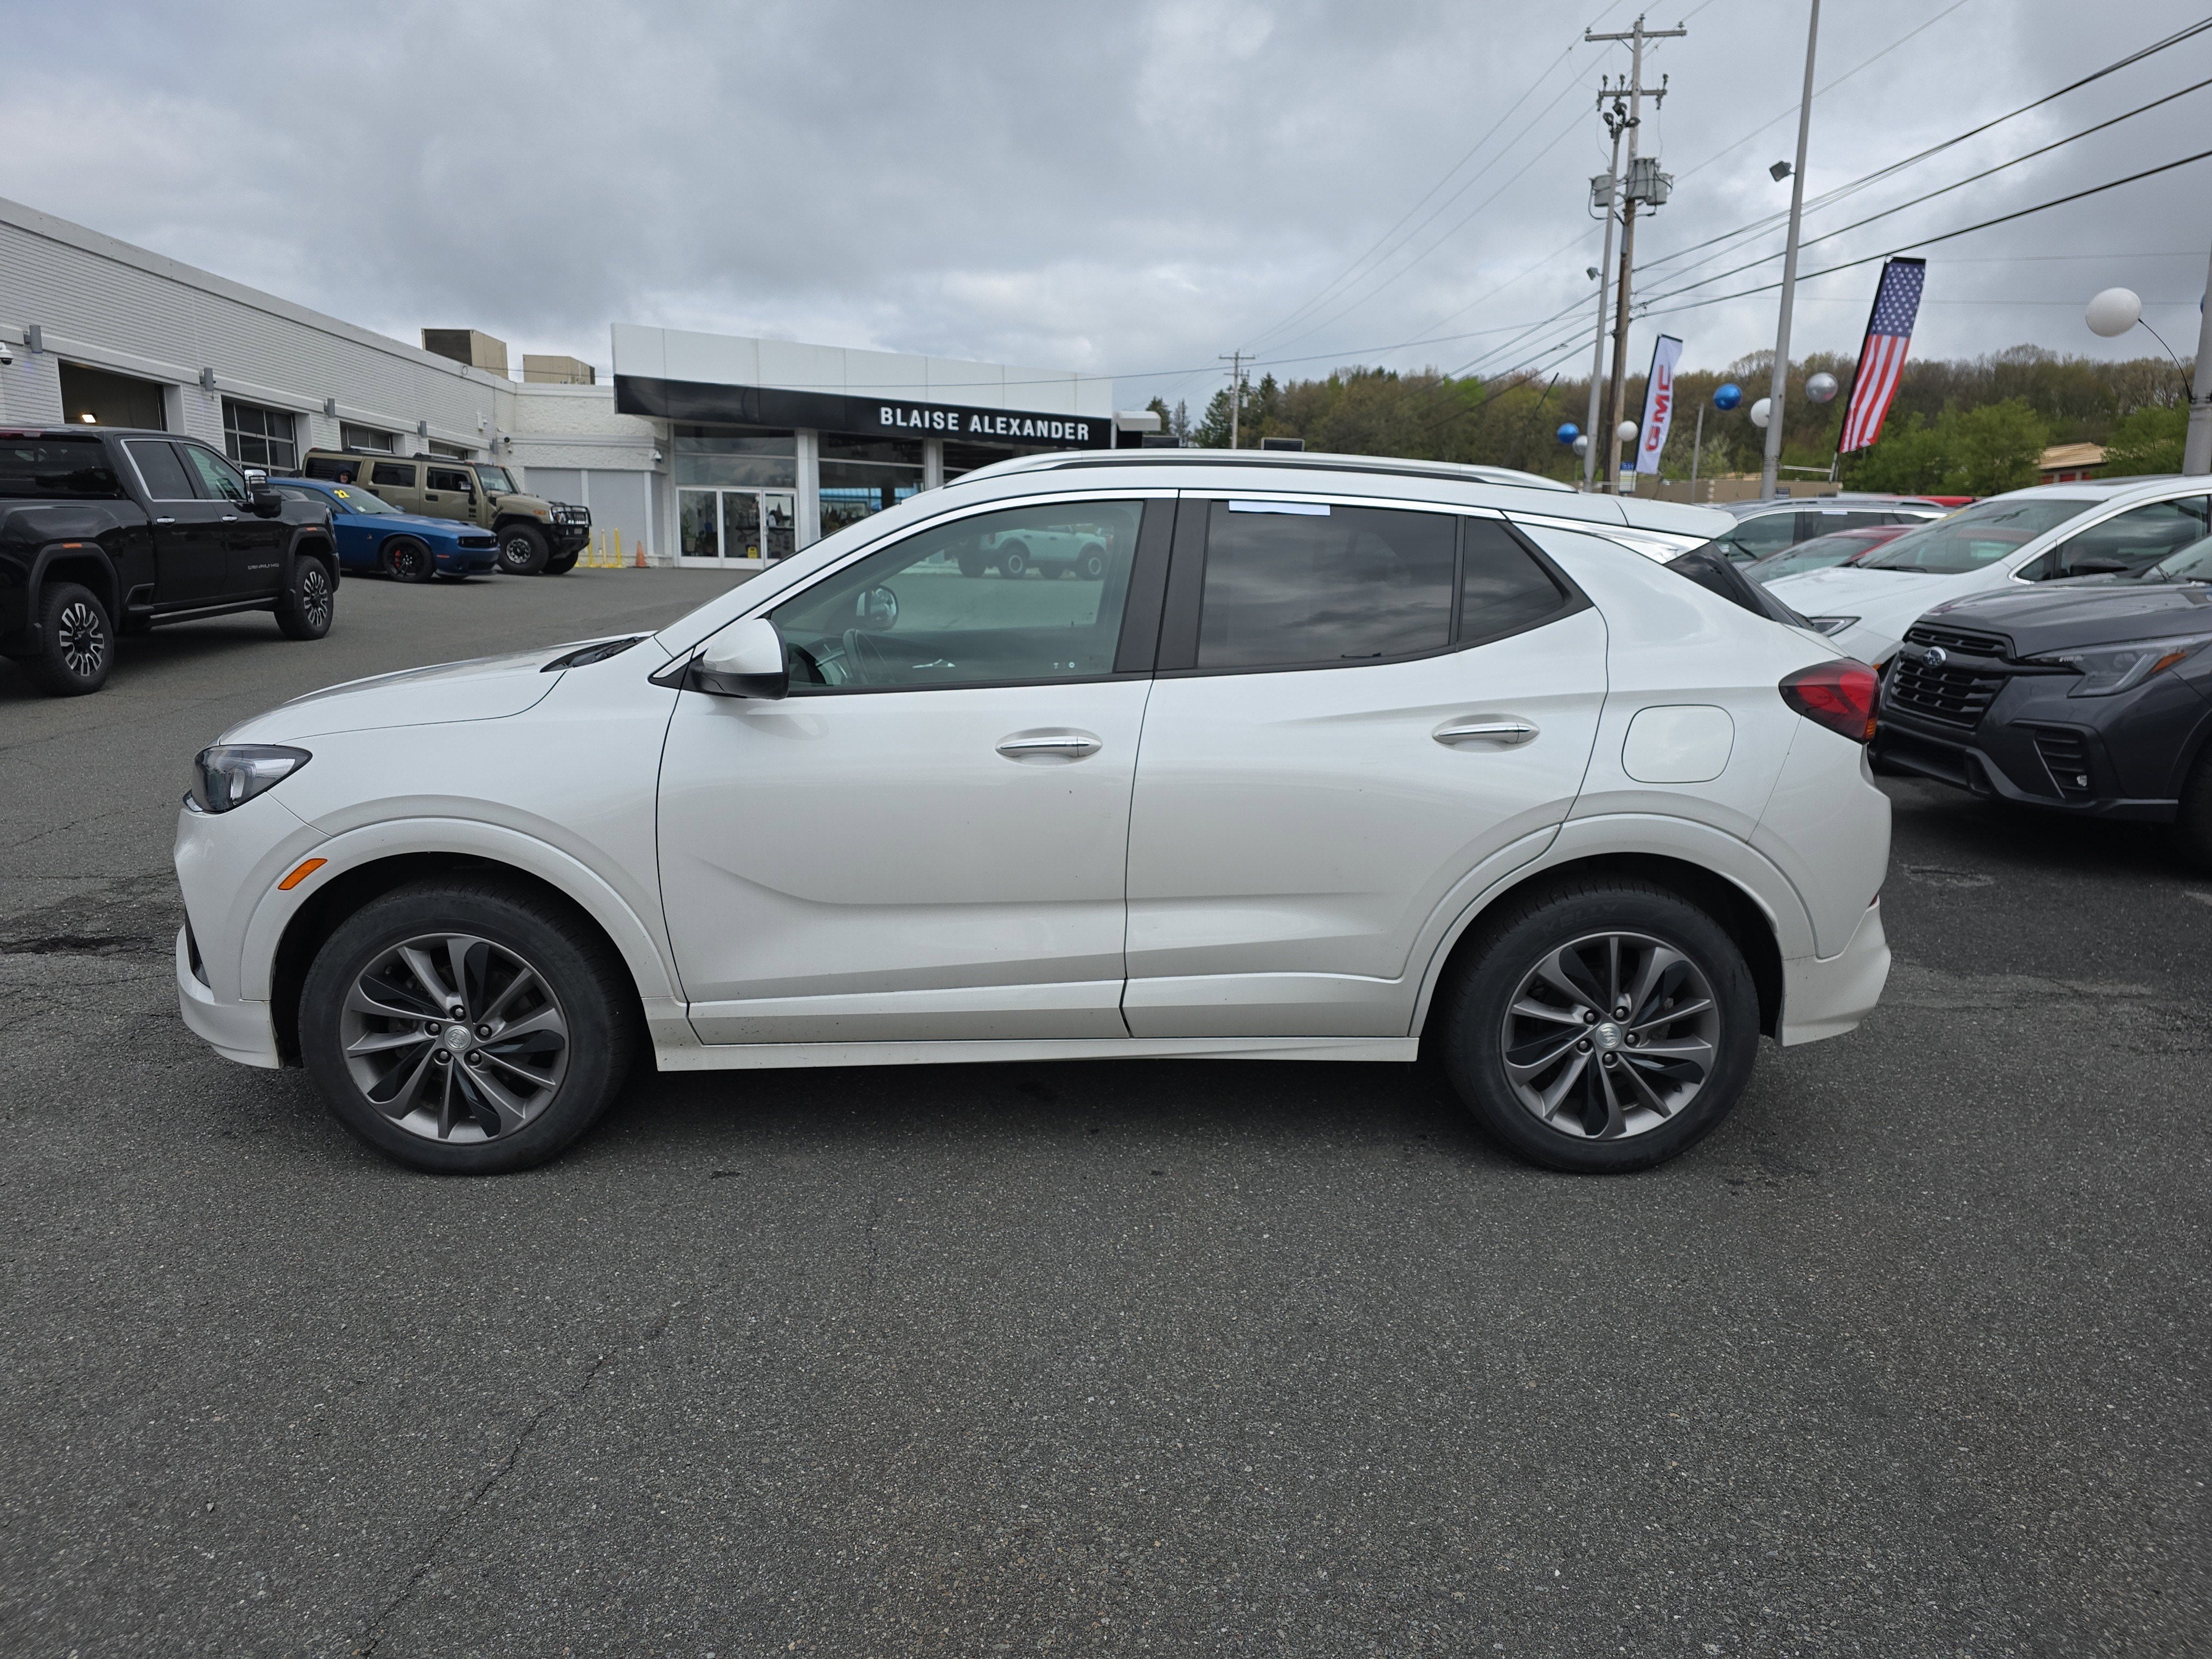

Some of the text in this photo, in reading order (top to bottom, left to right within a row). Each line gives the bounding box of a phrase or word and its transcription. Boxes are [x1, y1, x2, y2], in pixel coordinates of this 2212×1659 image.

[879, 407, 1089, 441] BLAISE ALEXANDER
[1645, 361, 1671, 452] GMC
